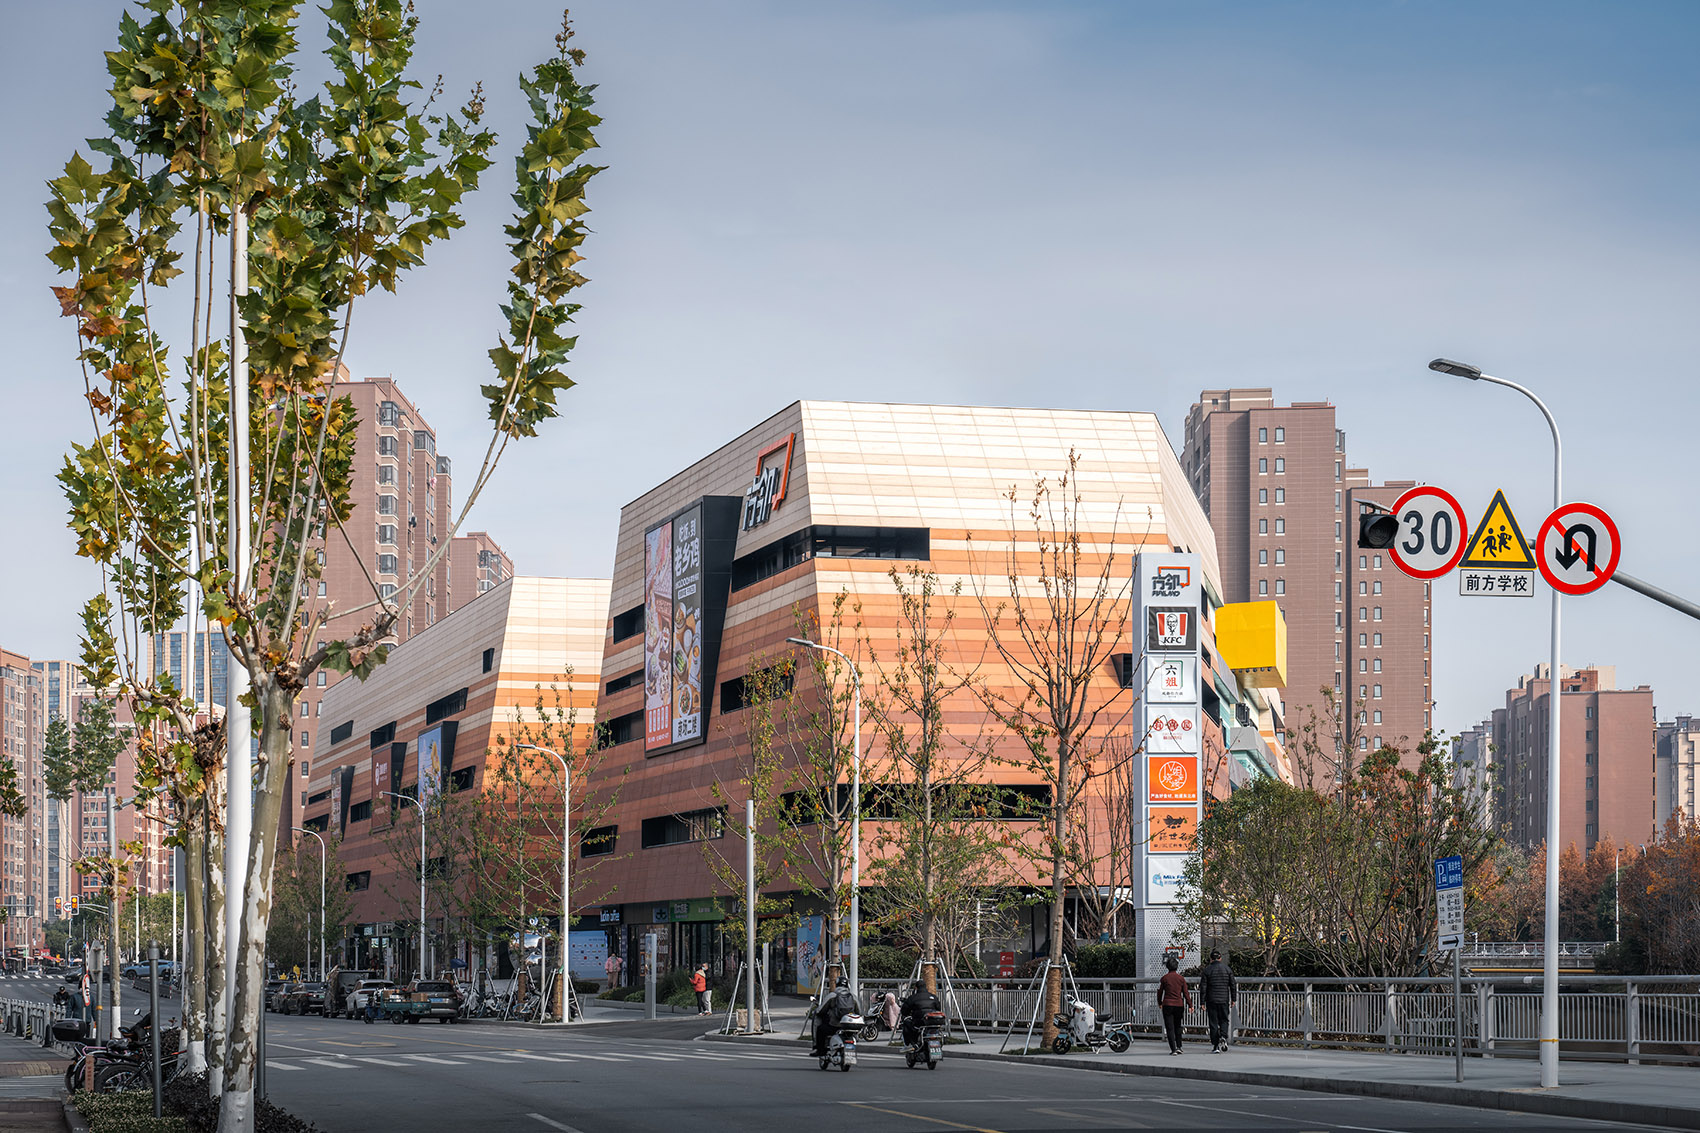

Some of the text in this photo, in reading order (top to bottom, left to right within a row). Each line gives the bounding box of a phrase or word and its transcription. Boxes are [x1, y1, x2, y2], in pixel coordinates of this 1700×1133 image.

[1402, 510, 1452, 556] 30
[674, 537, 700, 577] 老乡鸡
[1466, 574, 1528, 592] 前方学校
[1163, 636, 1183, 644] KFC
[1438, 864, 1445, 884] P
